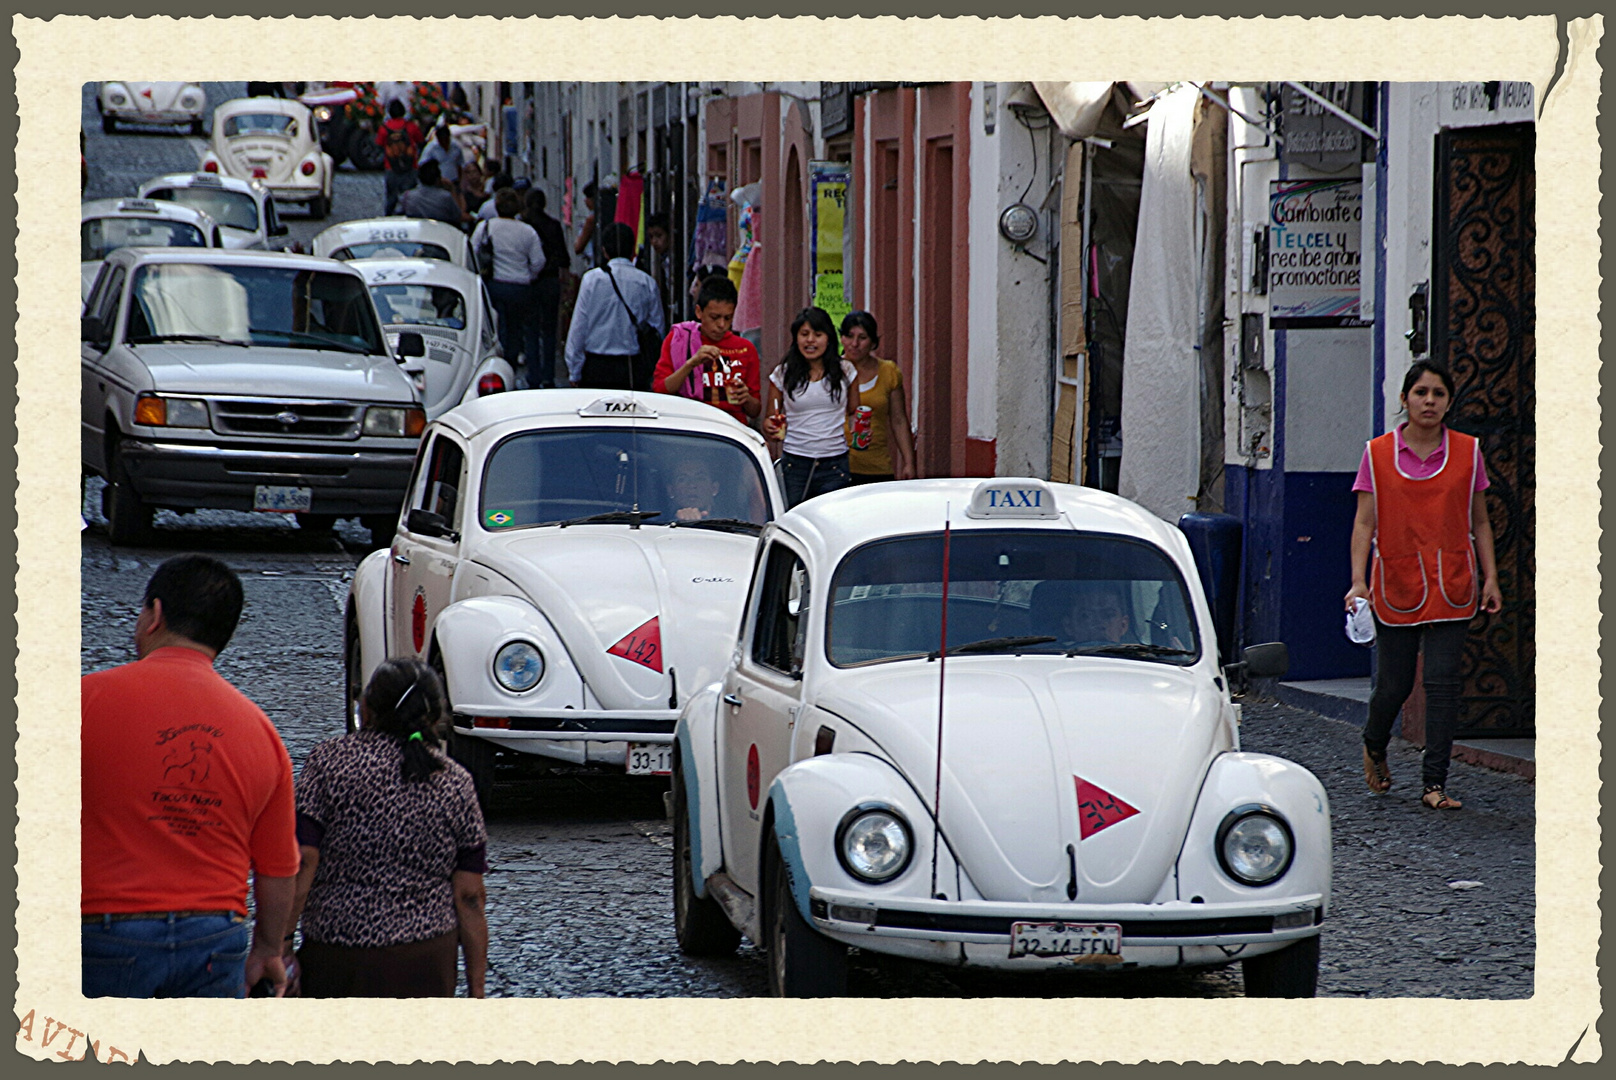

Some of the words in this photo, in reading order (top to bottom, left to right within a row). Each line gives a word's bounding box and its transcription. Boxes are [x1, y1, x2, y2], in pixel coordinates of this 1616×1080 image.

[1275, 202, 1350, 222] Cambiate
[1271, 227, 1333, 248] TELCEL
[1337, 233, 1347, 253] y
[1271, 248, 1322, 267] recibe
[1271, 268, 1361, 292] promociones
[605, 402, 637, 413] TAXI
[986, 489, 1043, 507] TAXI
[624, 636, 657, 665] 142
